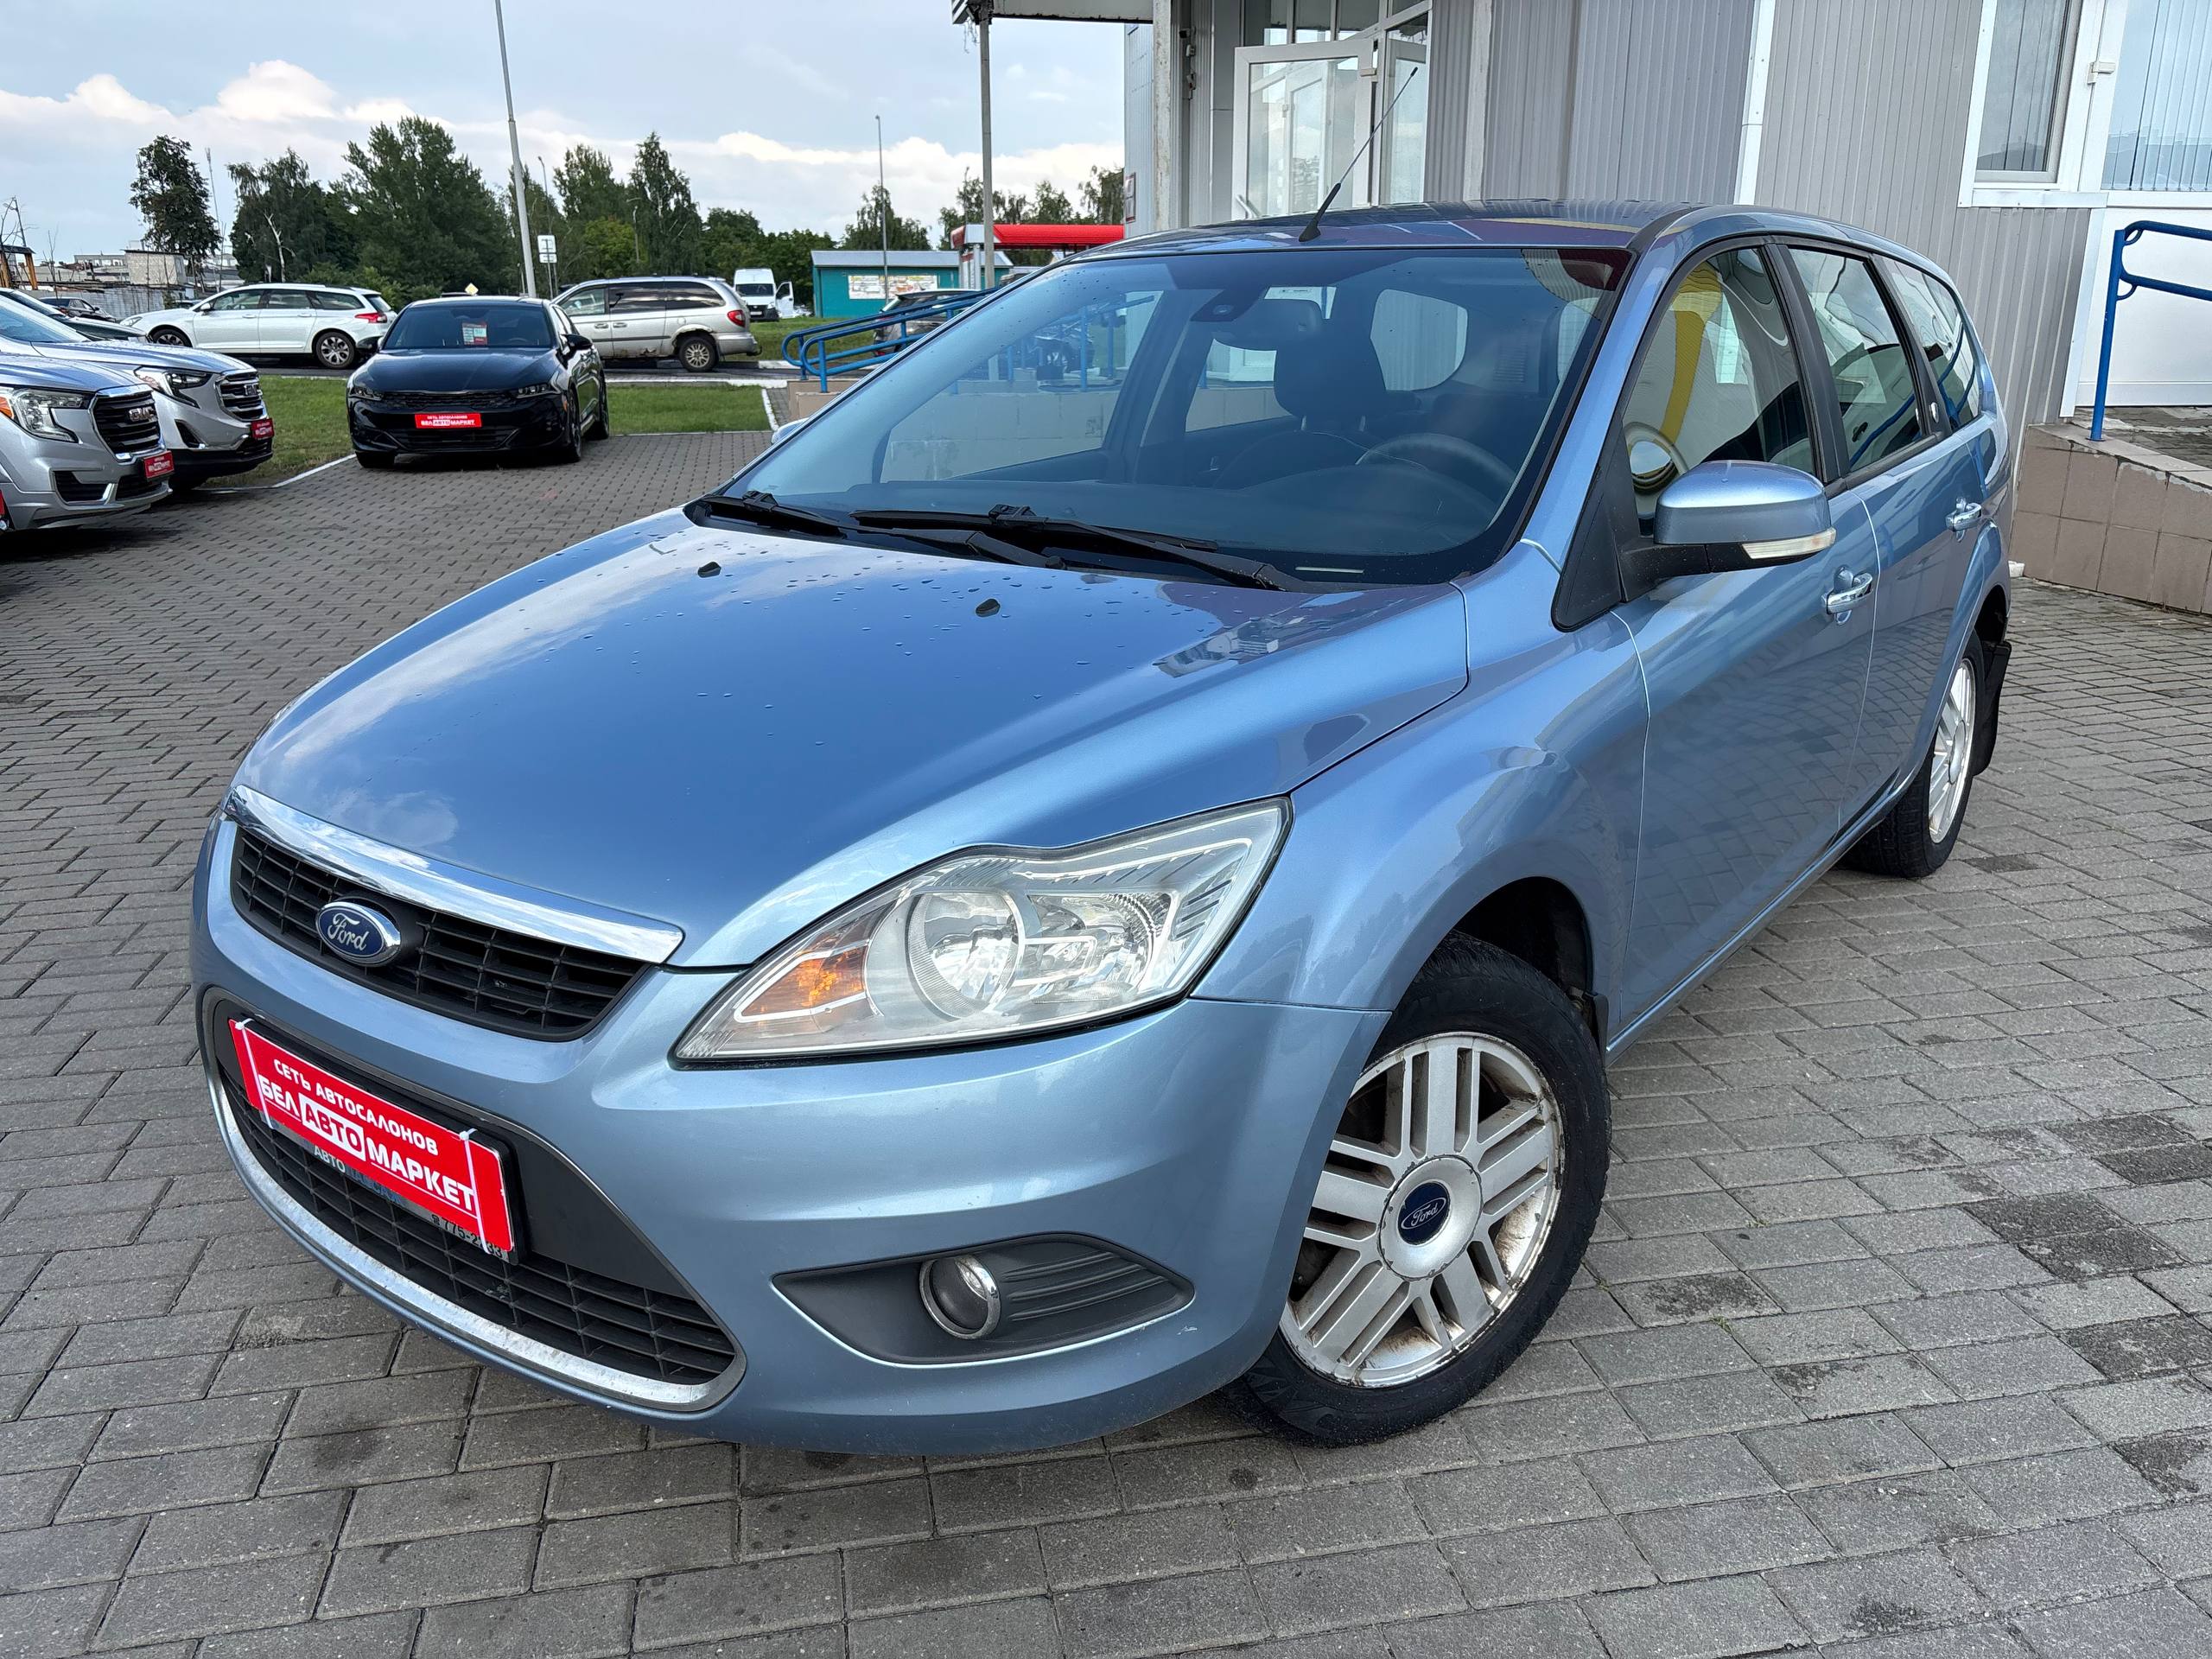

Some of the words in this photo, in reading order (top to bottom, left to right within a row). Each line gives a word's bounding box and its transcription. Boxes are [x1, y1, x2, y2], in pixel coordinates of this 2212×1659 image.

[327, 912, 370, 951] Ford
[273, 1058, 312, 1091] СЕТЬ
[315, 1082, 439, 1156] АВТОСАЛОНОВ
[1410, 1202, 1439, 1227] Ford
